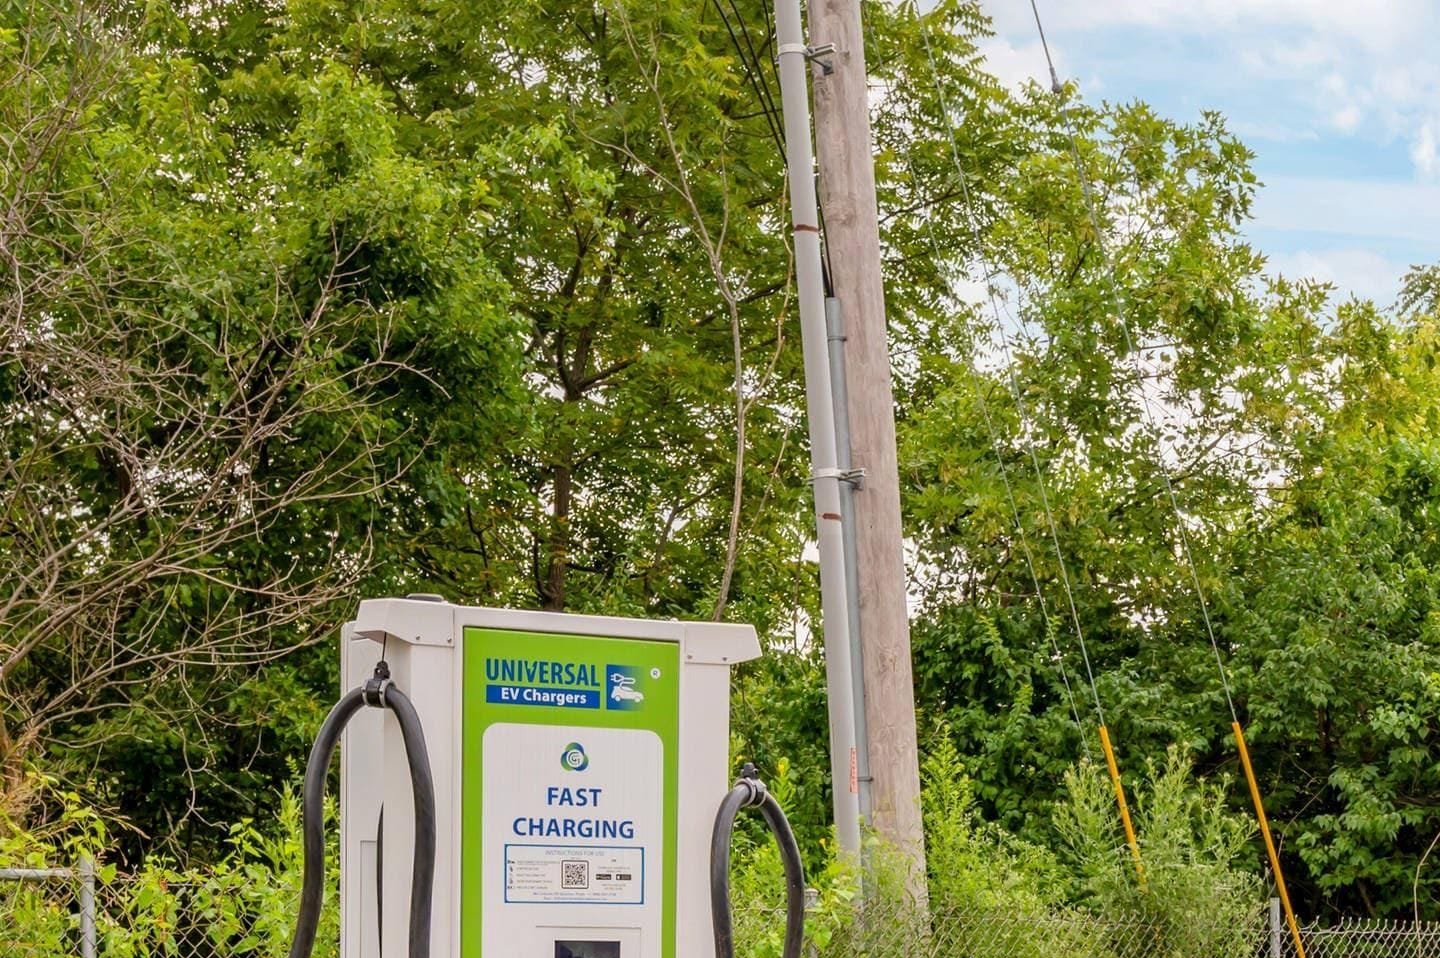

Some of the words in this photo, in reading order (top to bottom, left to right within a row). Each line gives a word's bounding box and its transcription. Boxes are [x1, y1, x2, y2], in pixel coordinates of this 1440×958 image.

[486, 658, 600, 687] UNIVERSAL
[501, 687, 519, 701] EV
[523, 689, 587, 705] Chargers
[547, 787, 602, 807] FAST
[512, 817, 635, 839] CHARGING
